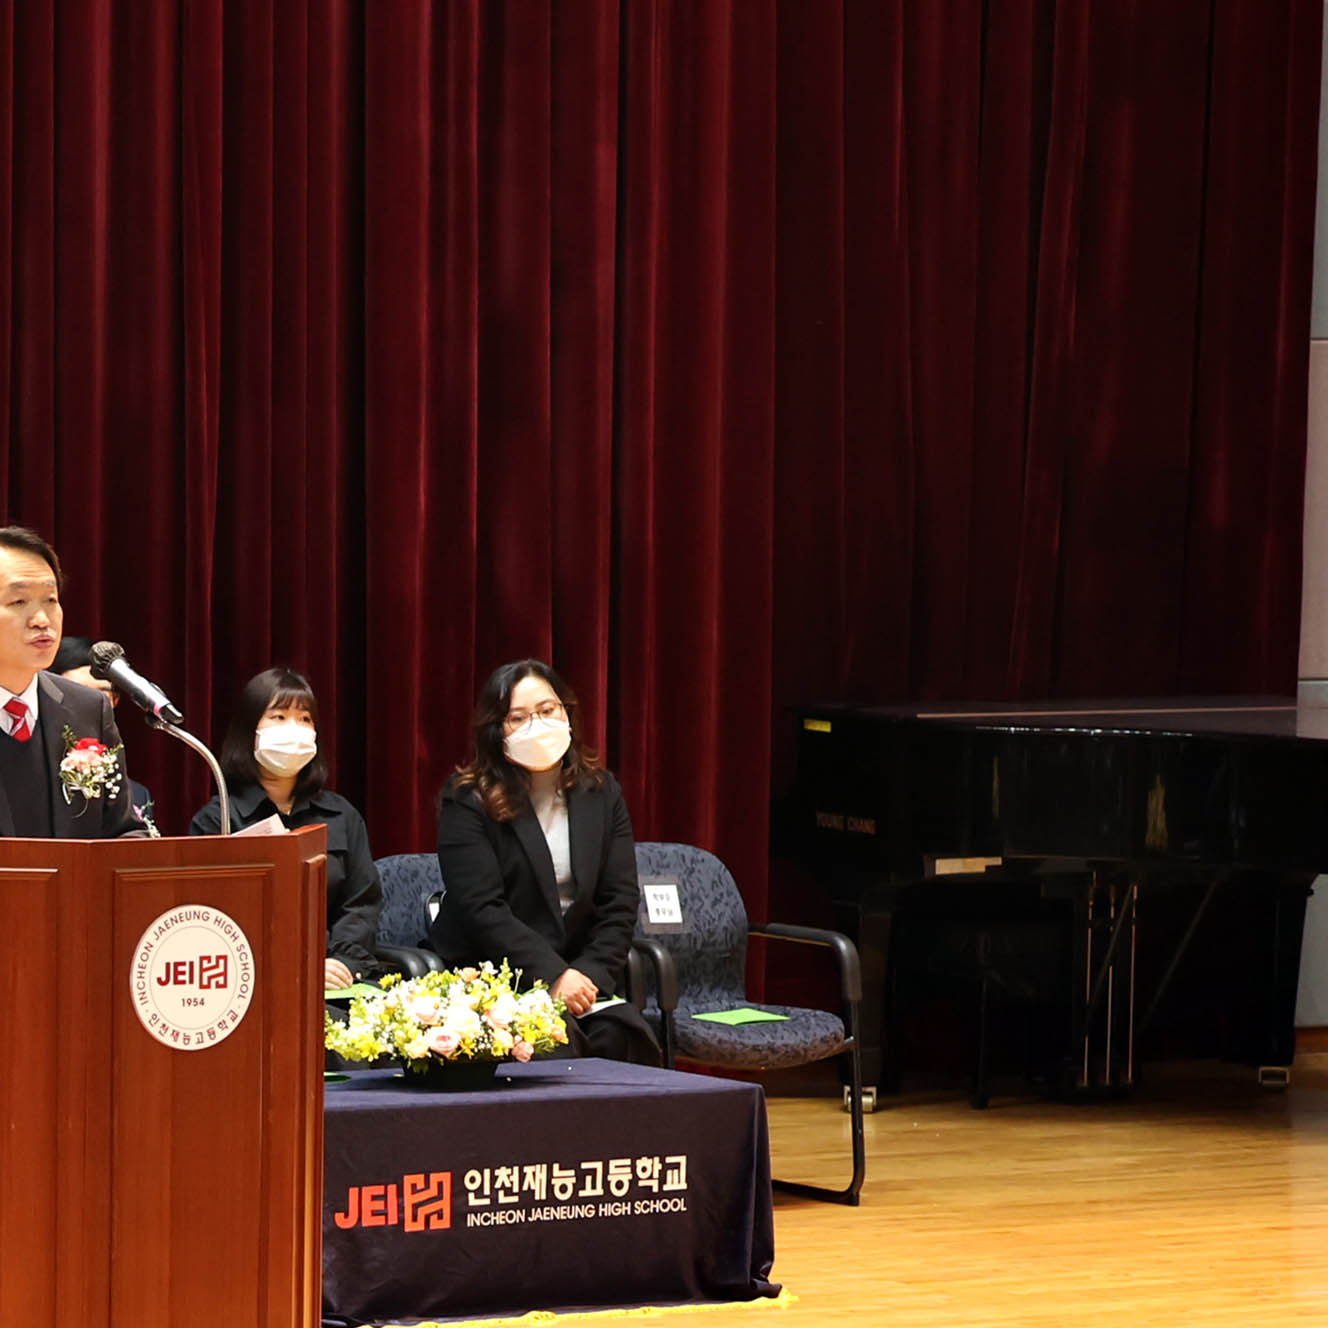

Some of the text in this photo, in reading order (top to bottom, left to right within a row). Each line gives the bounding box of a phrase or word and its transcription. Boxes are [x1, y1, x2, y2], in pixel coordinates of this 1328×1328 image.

[136, 911, 251, 1005] INCHEON JAENEUNG HIGH SCHOOL
[156, 961, 194, 986] JEI
[181, 997, 205, 1007] 1954
[463, 1156, 688, 1207] 인천재능고등학교
[333, 1184, 399, 1230] JEI
[466, 1197, 688, 1228] INCHEON JAENEUNG HIGH SCHOOL
